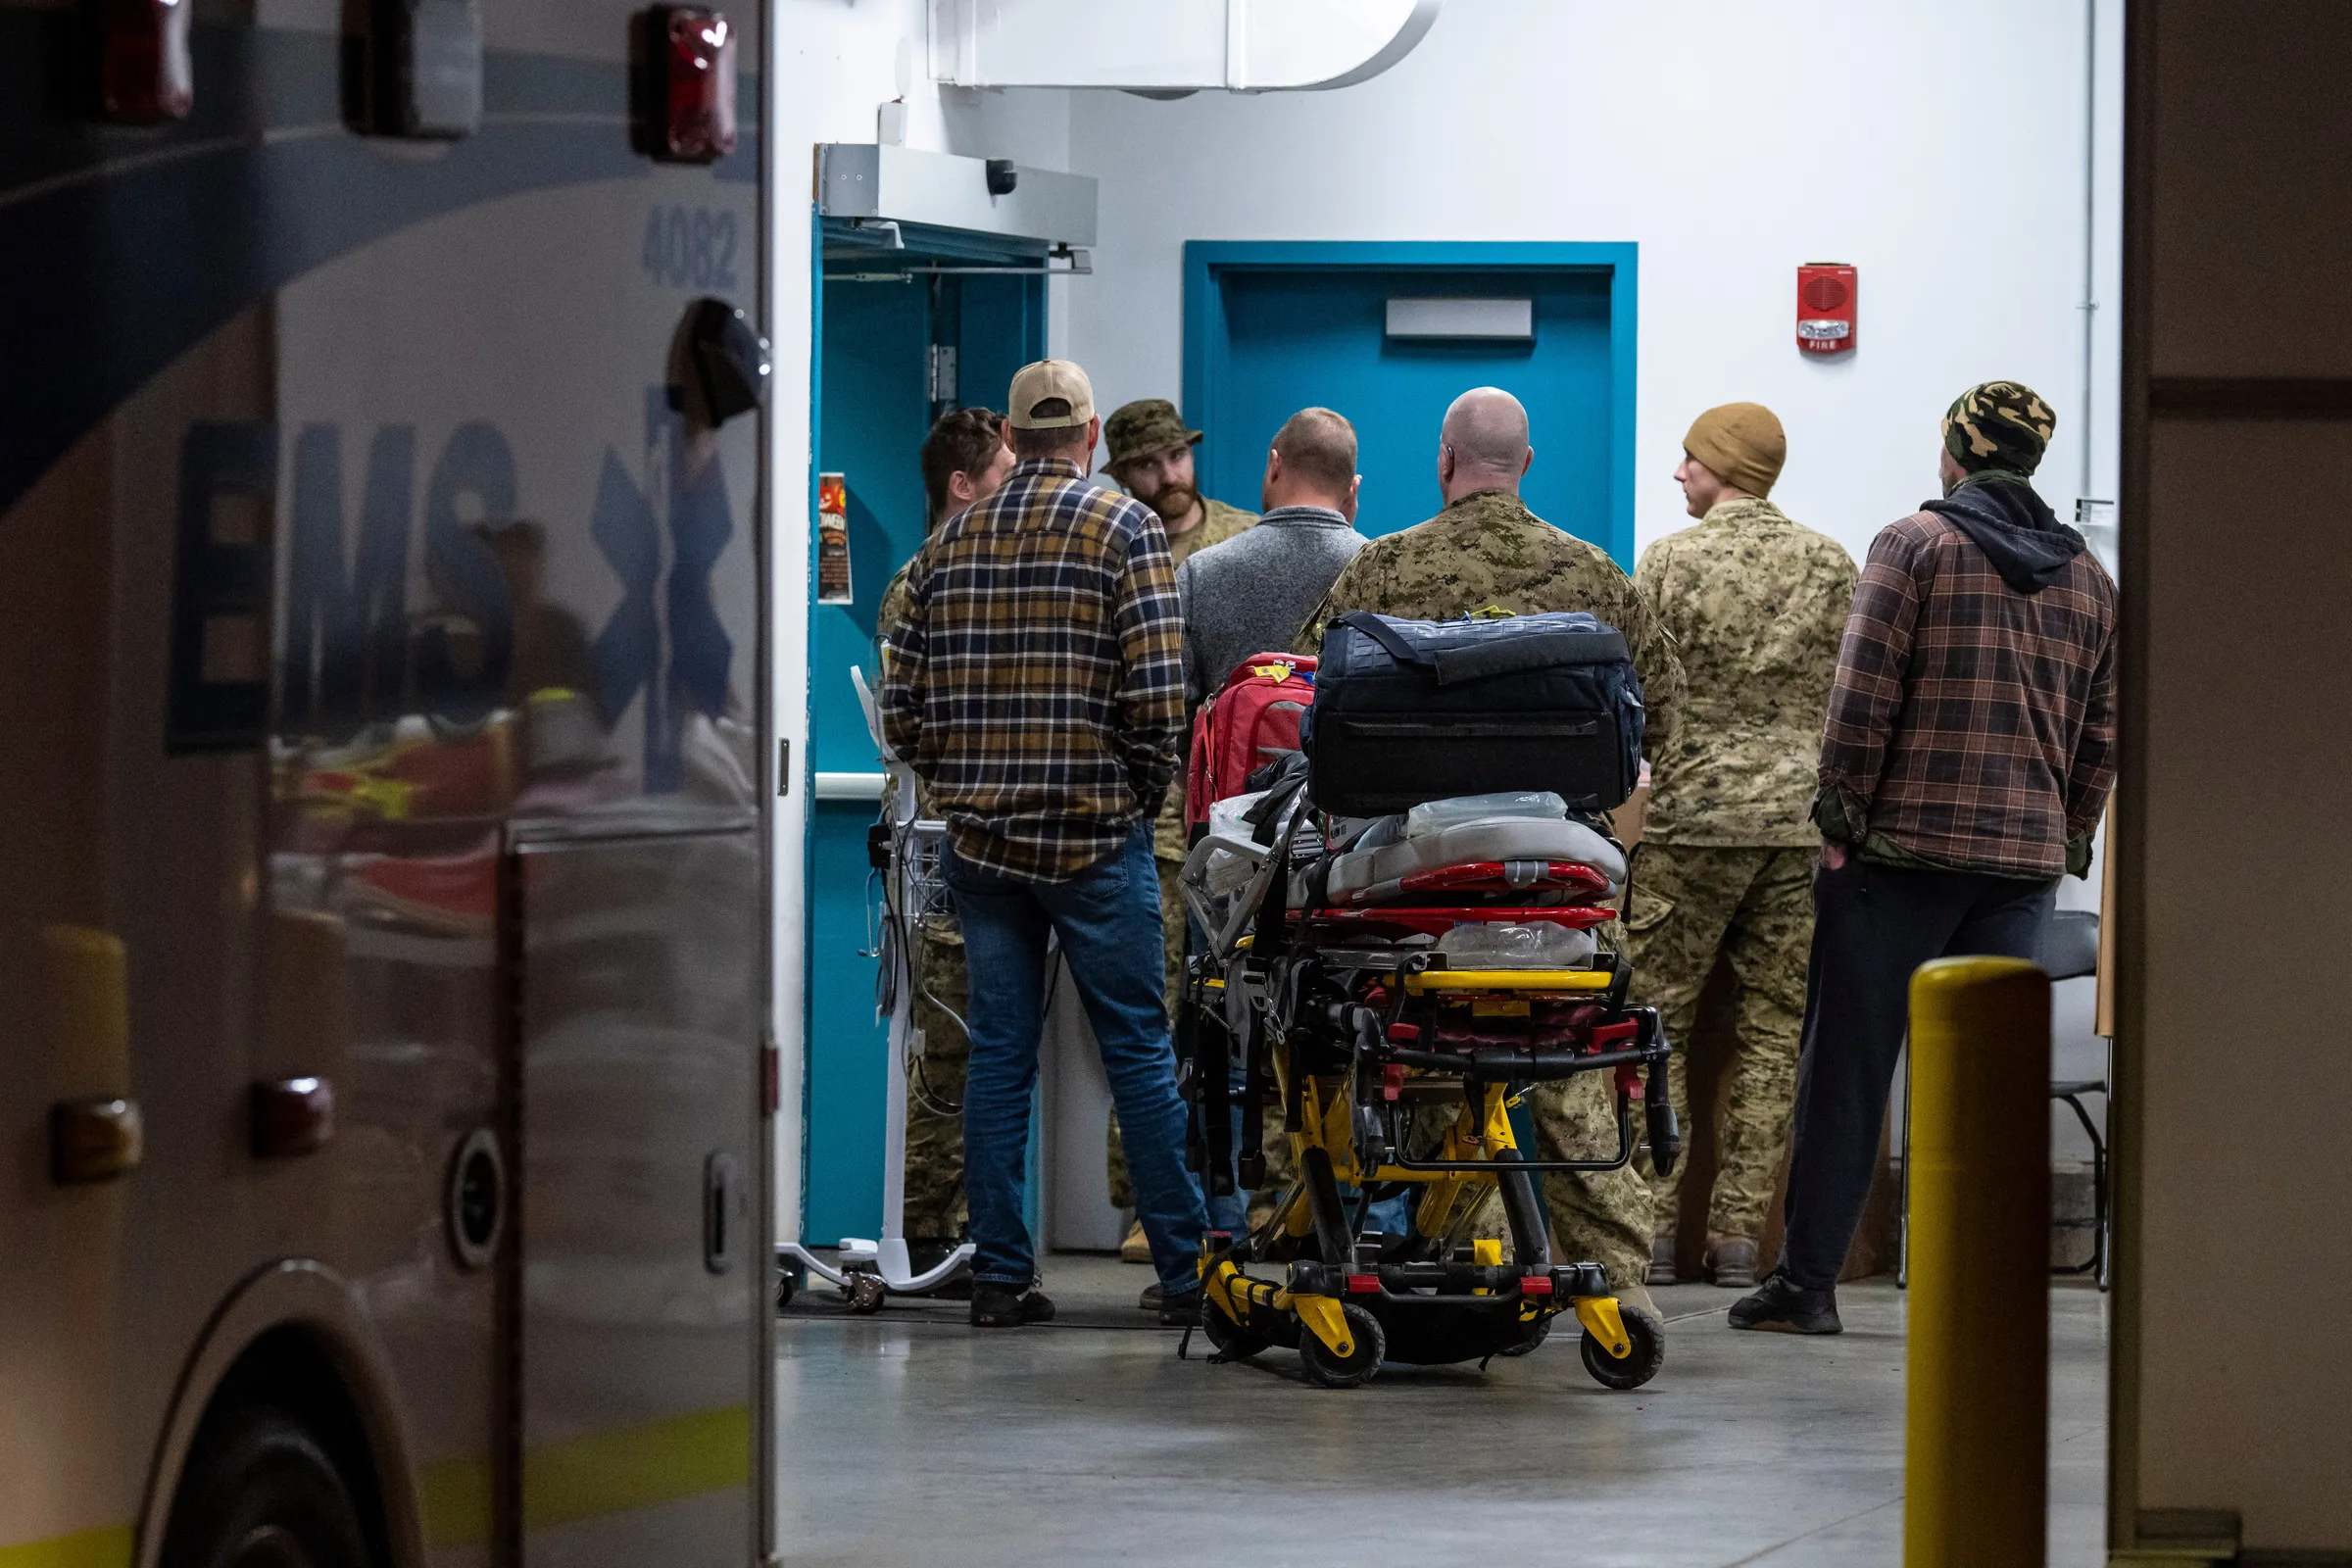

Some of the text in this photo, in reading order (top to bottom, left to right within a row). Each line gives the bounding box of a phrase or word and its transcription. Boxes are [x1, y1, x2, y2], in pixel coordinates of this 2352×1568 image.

[641, 206, 737, 290] 4082
[1808, 339, 1837, 350] FIRE
[165, 420, 516, 756] EMS
